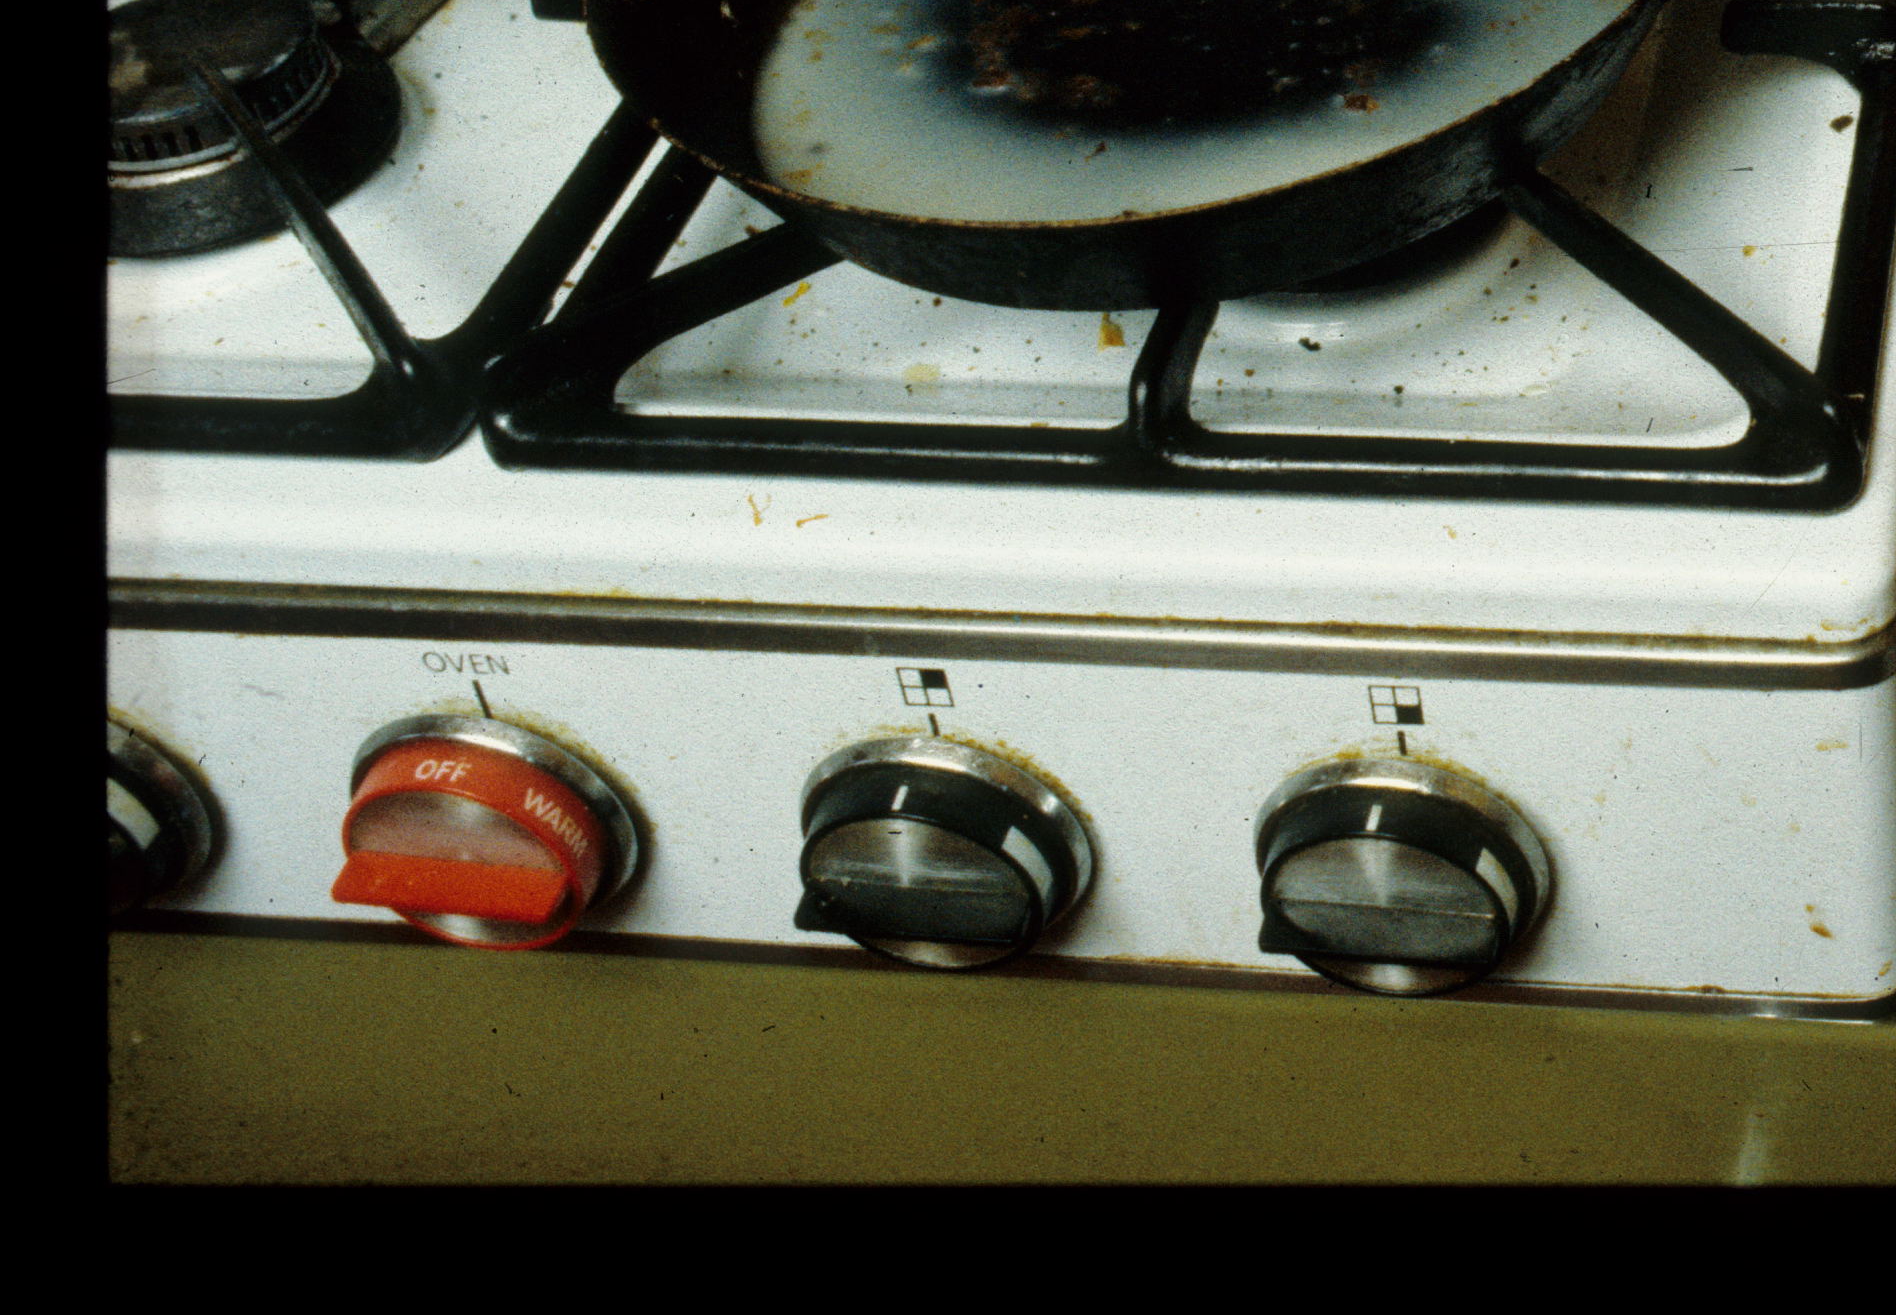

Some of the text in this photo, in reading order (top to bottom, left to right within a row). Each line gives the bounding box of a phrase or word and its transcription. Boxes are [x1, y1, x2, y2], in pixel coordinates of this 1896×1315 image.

[421, 650, 511, 675] OVEN
[414, 758, 472, 782] OFF
[523, 787, 589, 859] WARM
